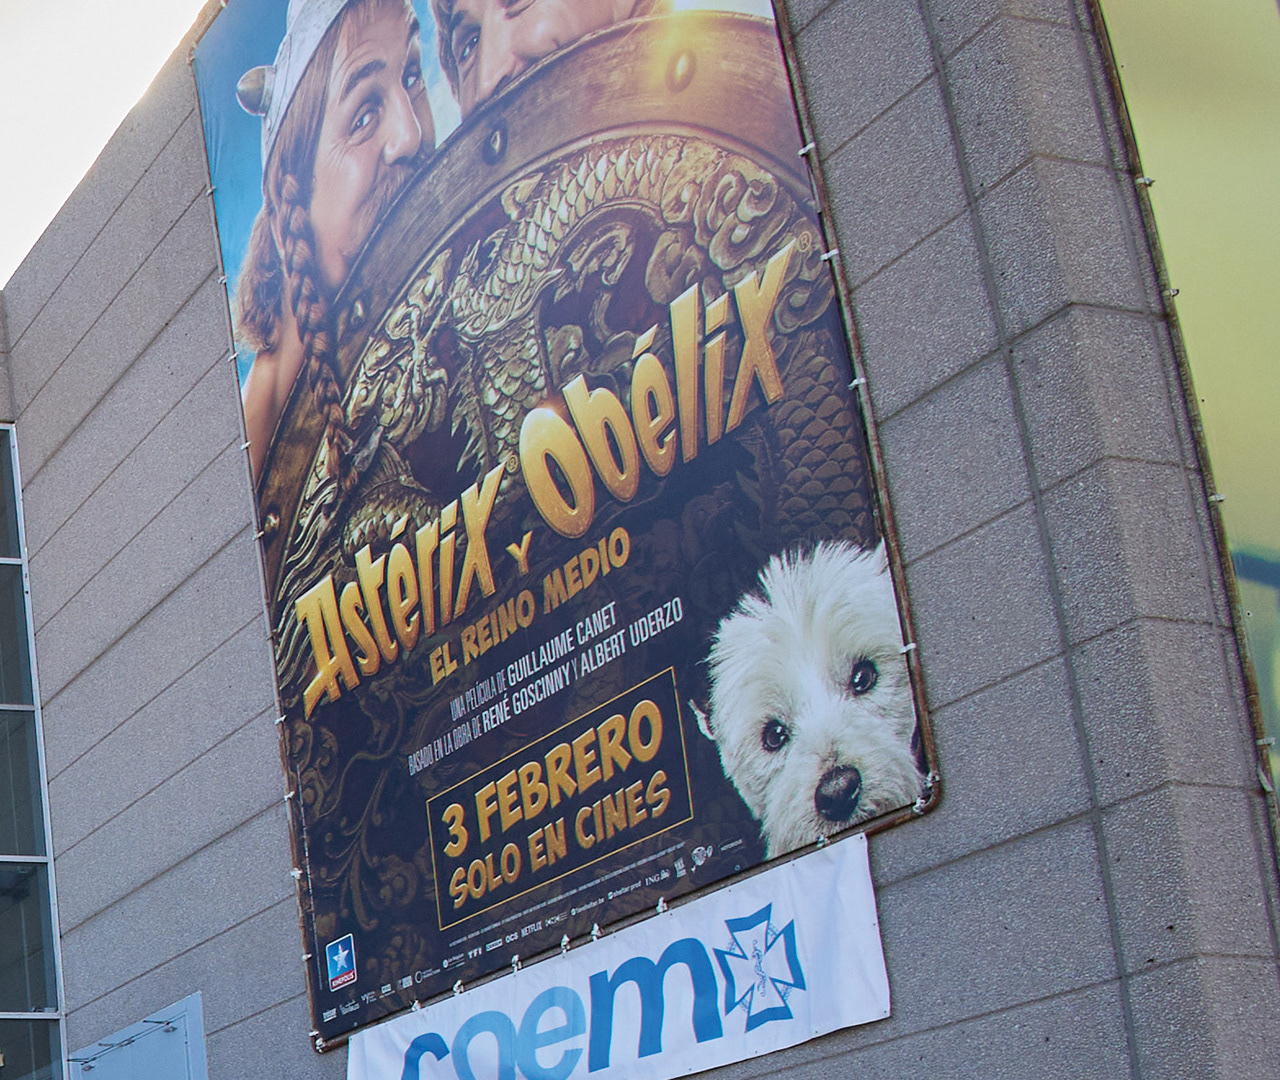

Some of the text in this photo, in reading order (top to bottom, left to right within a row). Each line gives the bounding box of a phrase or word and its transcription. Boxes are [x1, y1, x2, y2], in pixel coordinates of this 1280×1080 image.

[429, 527, 630, 686] EL REINO MEDIO
[507, 532, 533, 576] Y
[408, 597, 684, 776] BASADO EN LA OBRA DE RENÉ GOSCINNY Y ALBERT UDERZO
[450, 695, 466, 721] UNA
[496, 669, 507, 694] DE
[506, 628, 576, 687] GUILLAUME
[575, 601, 616, 645] CANET
[441, 699, 663, 858] 3 FEBRERO
[448, 769, 671, 909] SOLO EN CINES
